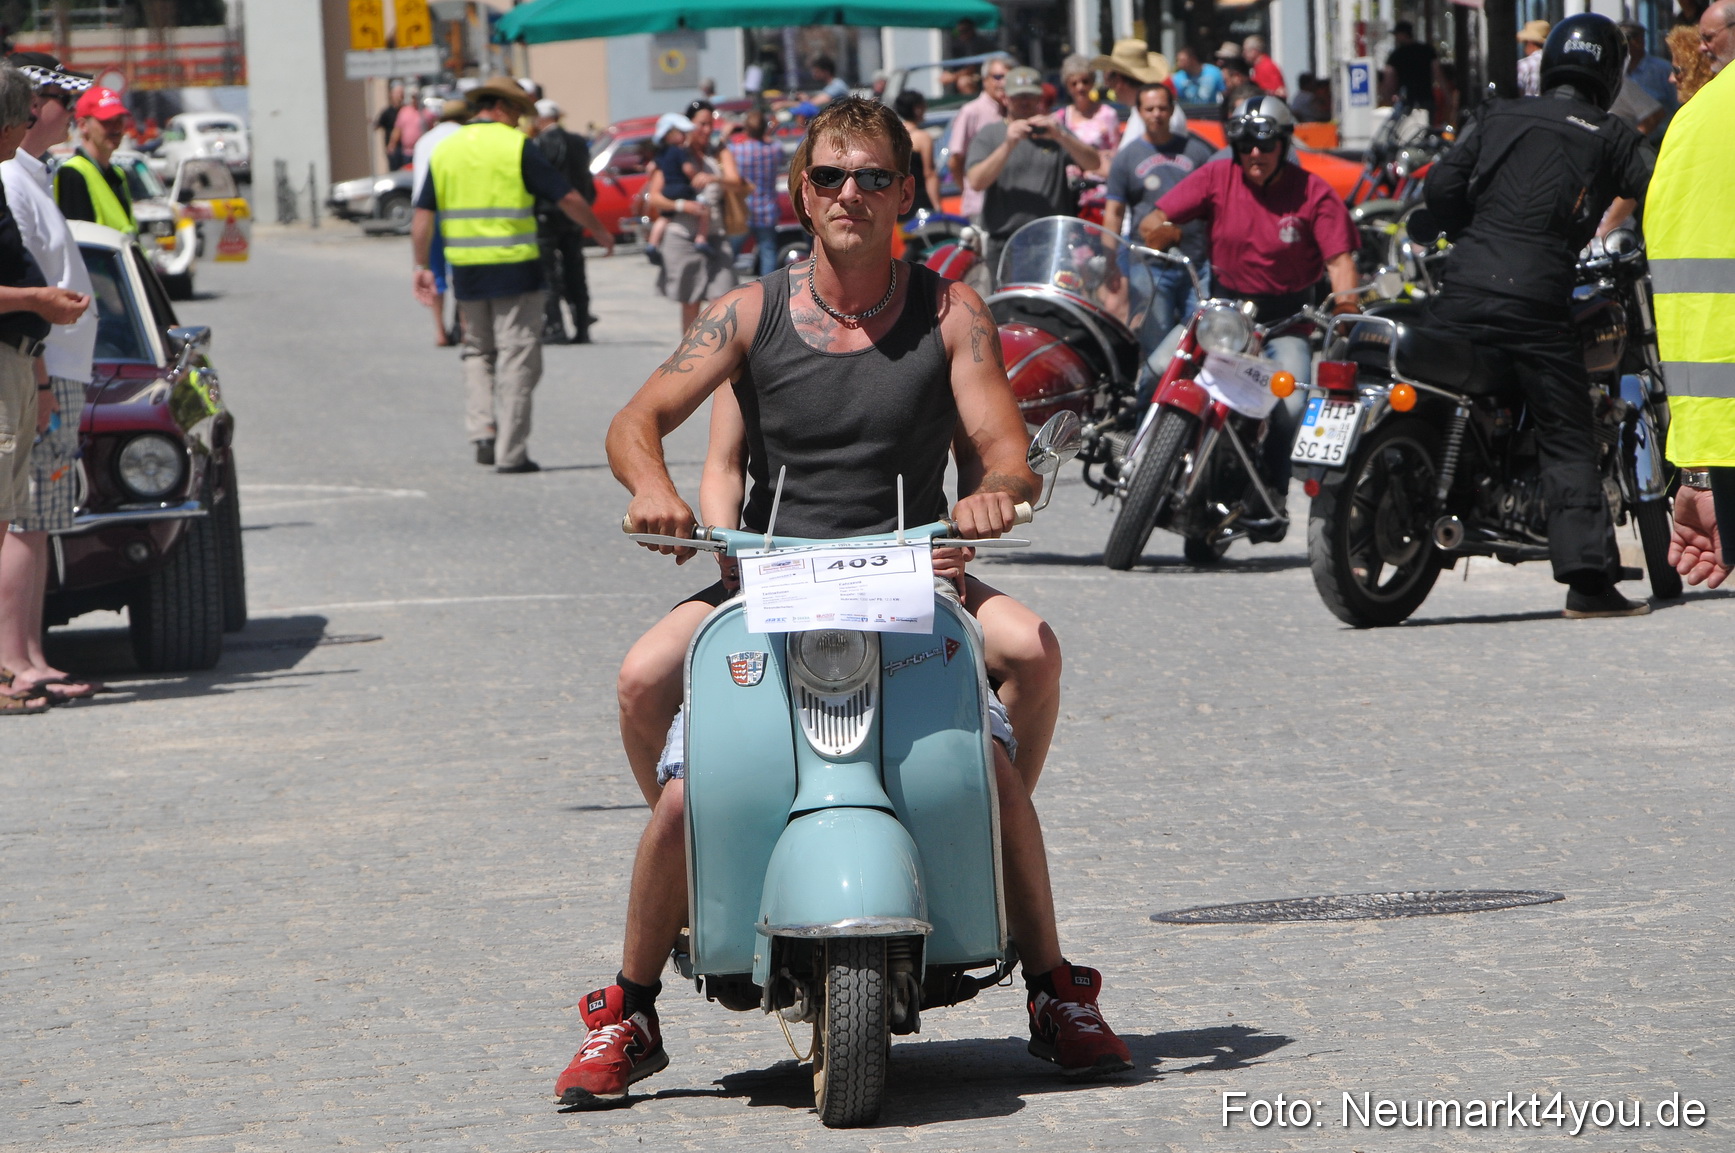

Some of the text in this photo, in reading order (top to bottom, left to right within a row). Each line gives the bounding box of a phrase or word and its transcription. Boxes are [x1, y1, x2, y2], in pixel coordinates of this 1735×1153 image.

[1351, 68, 1367, 90] P
[1320, 402, 1356, 420] HIP
[1294, 441, 1344, 461] SC 15
[827, 555, 889, 570] 403
[590, 1001, 602, 1010] 574
